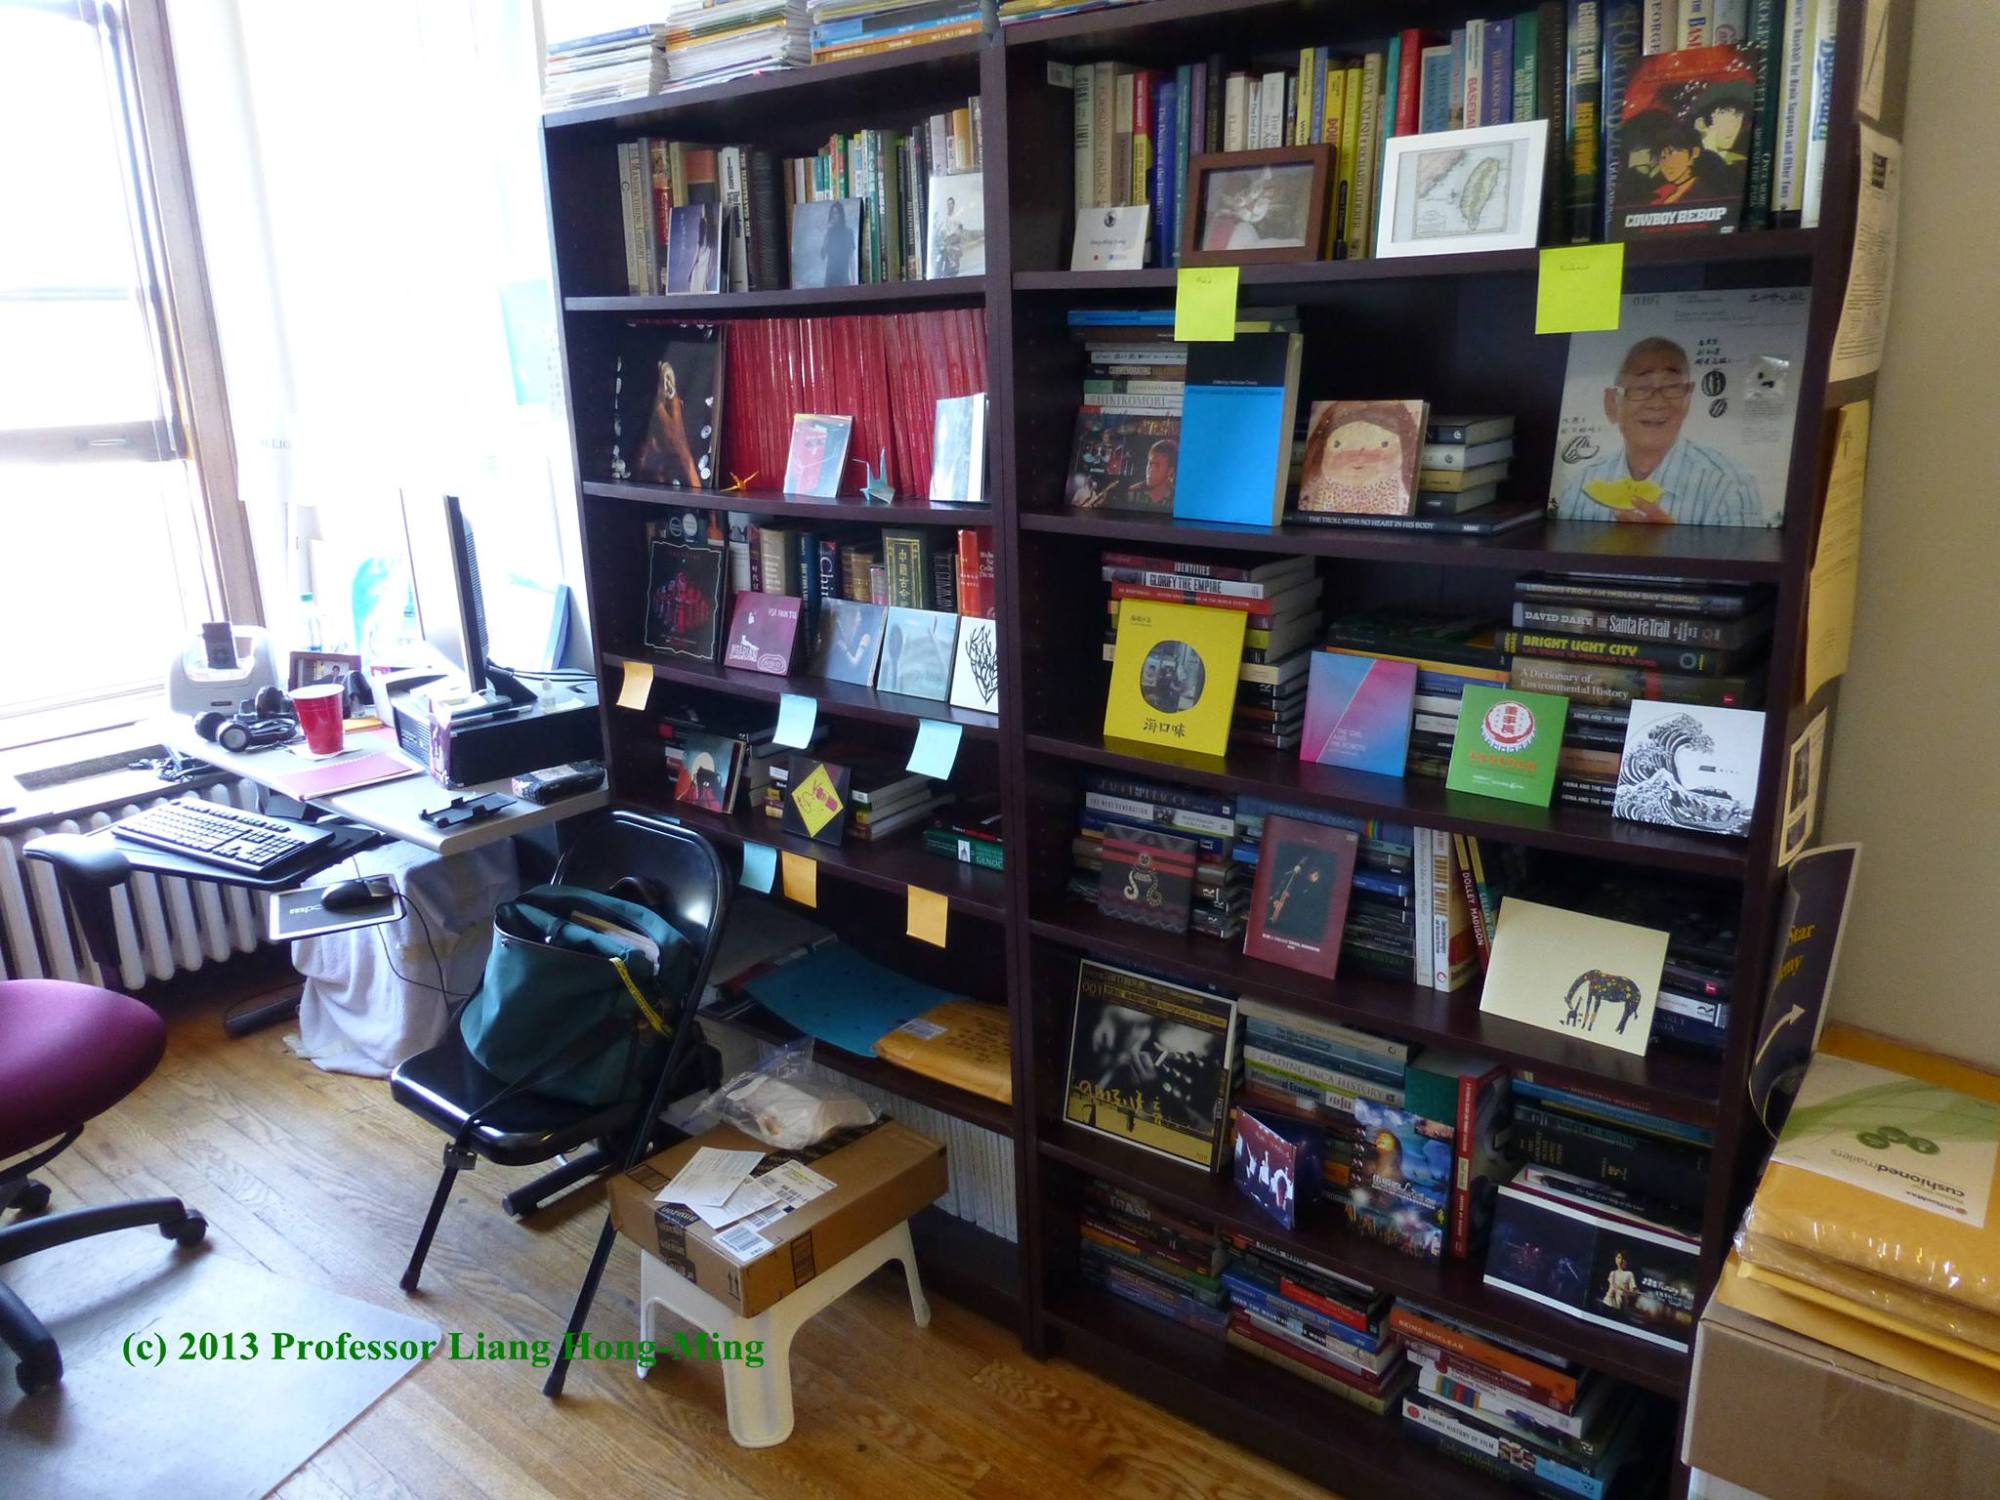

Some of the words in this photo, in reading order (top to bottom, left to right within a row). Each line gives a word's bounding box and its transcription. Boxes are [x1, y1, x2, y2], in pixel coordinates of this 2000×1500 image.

[1624, 212, 1678, 228] COWBOY
[1677, 207, 1727, 223] BEBOP
[1525, 612, 1559, 621] DAVID
[1560, 614, 1593, 626] DARY
[1609, 615, 1636, 634] Santa
[1637, 617, 1649, 635] Fe
[1649, 618, 1670, 638] Trail
[1522, 635, 1568, 650] BRIGHT
[1571, 640, 1606, 654] LIGHT
[1609, 644, 1638, 656] CITY
[1528, 670, 1578, 682] Dictionary
[1581, 674, 1592, 682] of
[1521, 680, 1590, 694] Environmental
[1592, 686, 1628, 700] History
[1462, 872, 1475, 904] DOLLEY
[1469, 908, 1484, 946] MADISON
